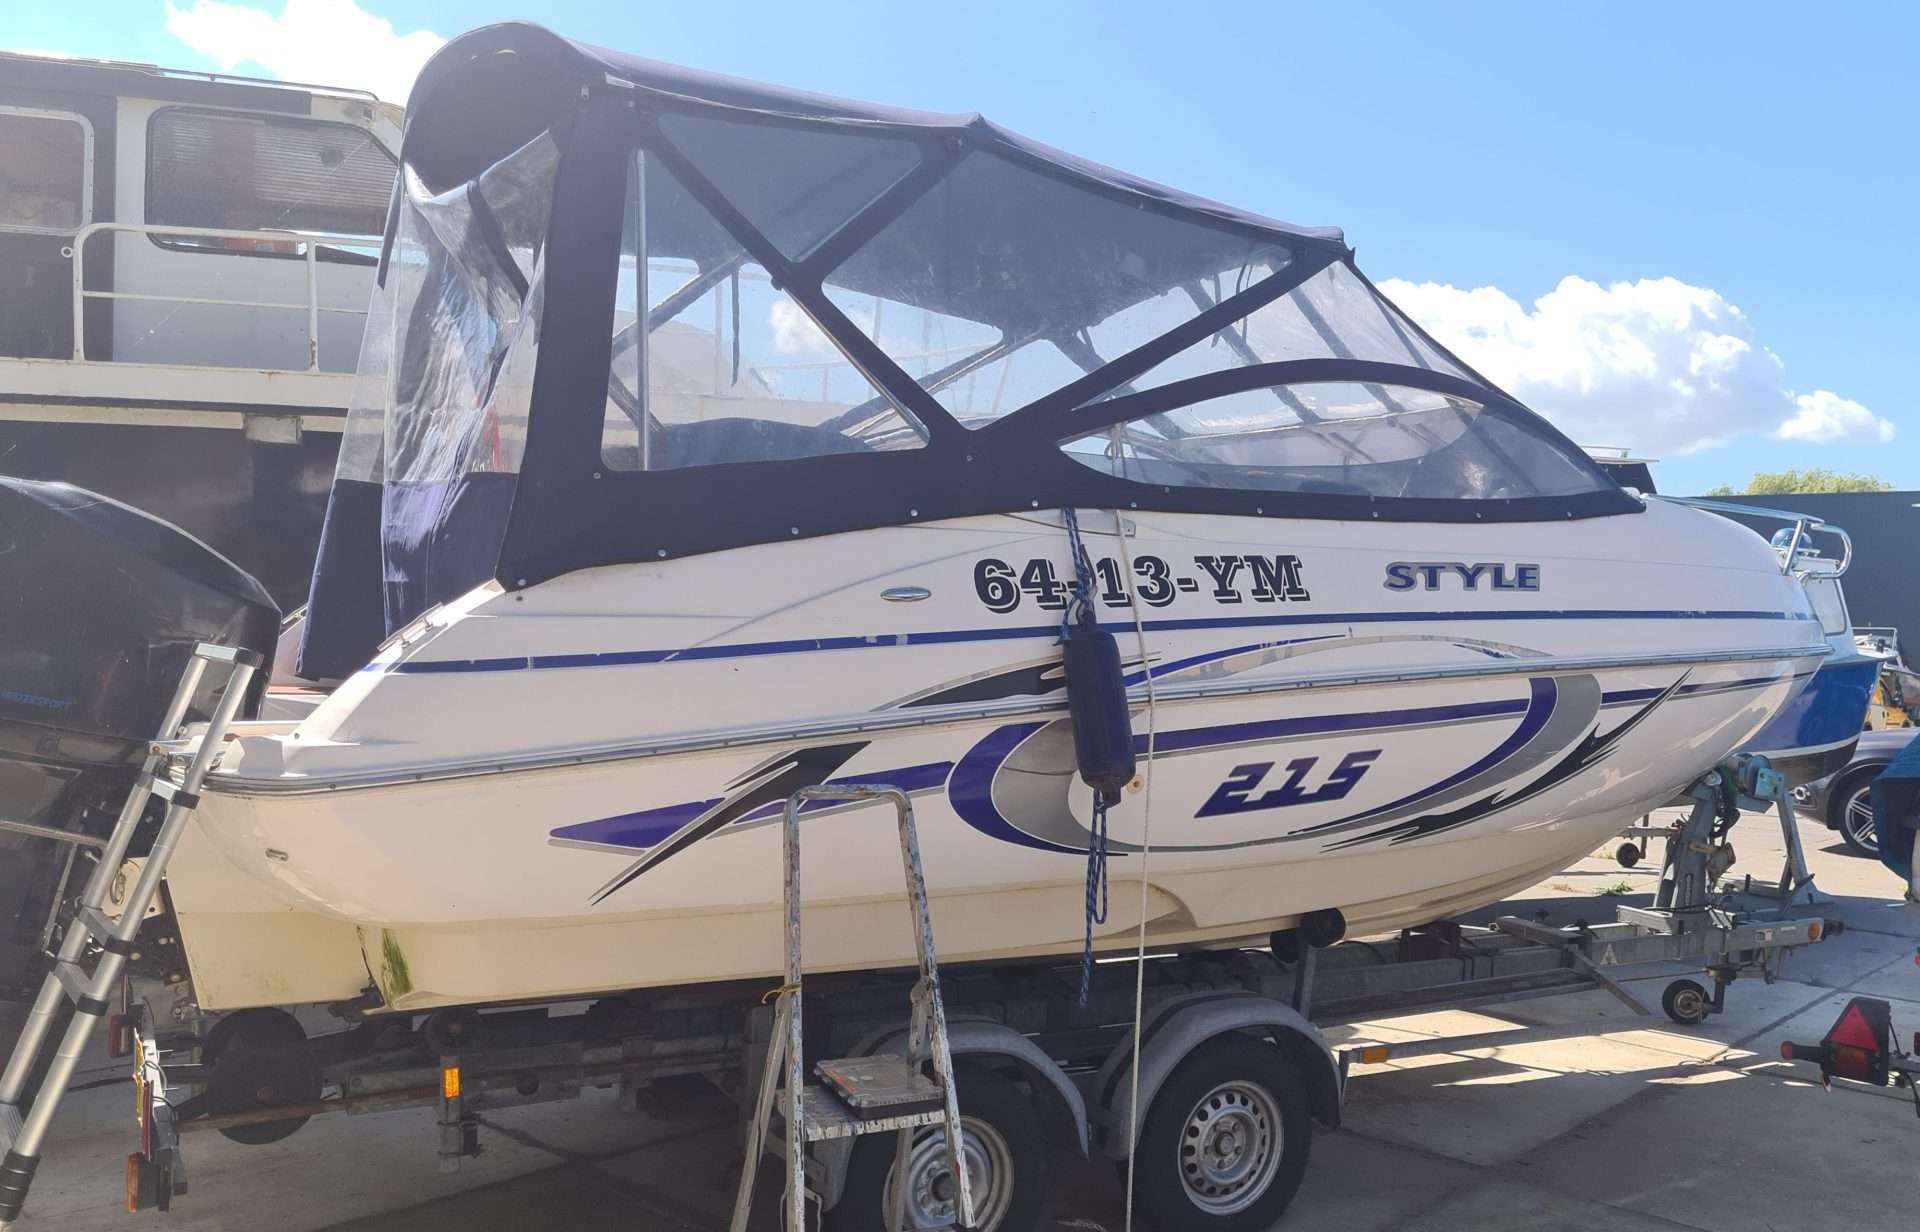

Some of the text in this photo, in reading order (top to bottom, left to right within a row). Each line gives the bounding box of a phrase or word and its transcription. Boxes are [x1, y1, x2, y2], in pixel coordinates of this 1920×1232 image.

[974, 554, 1311, 613] 64-13-YM
[1384, 562, 1540, 591] STYLE
[1194, 749, 1383, 818] 215
